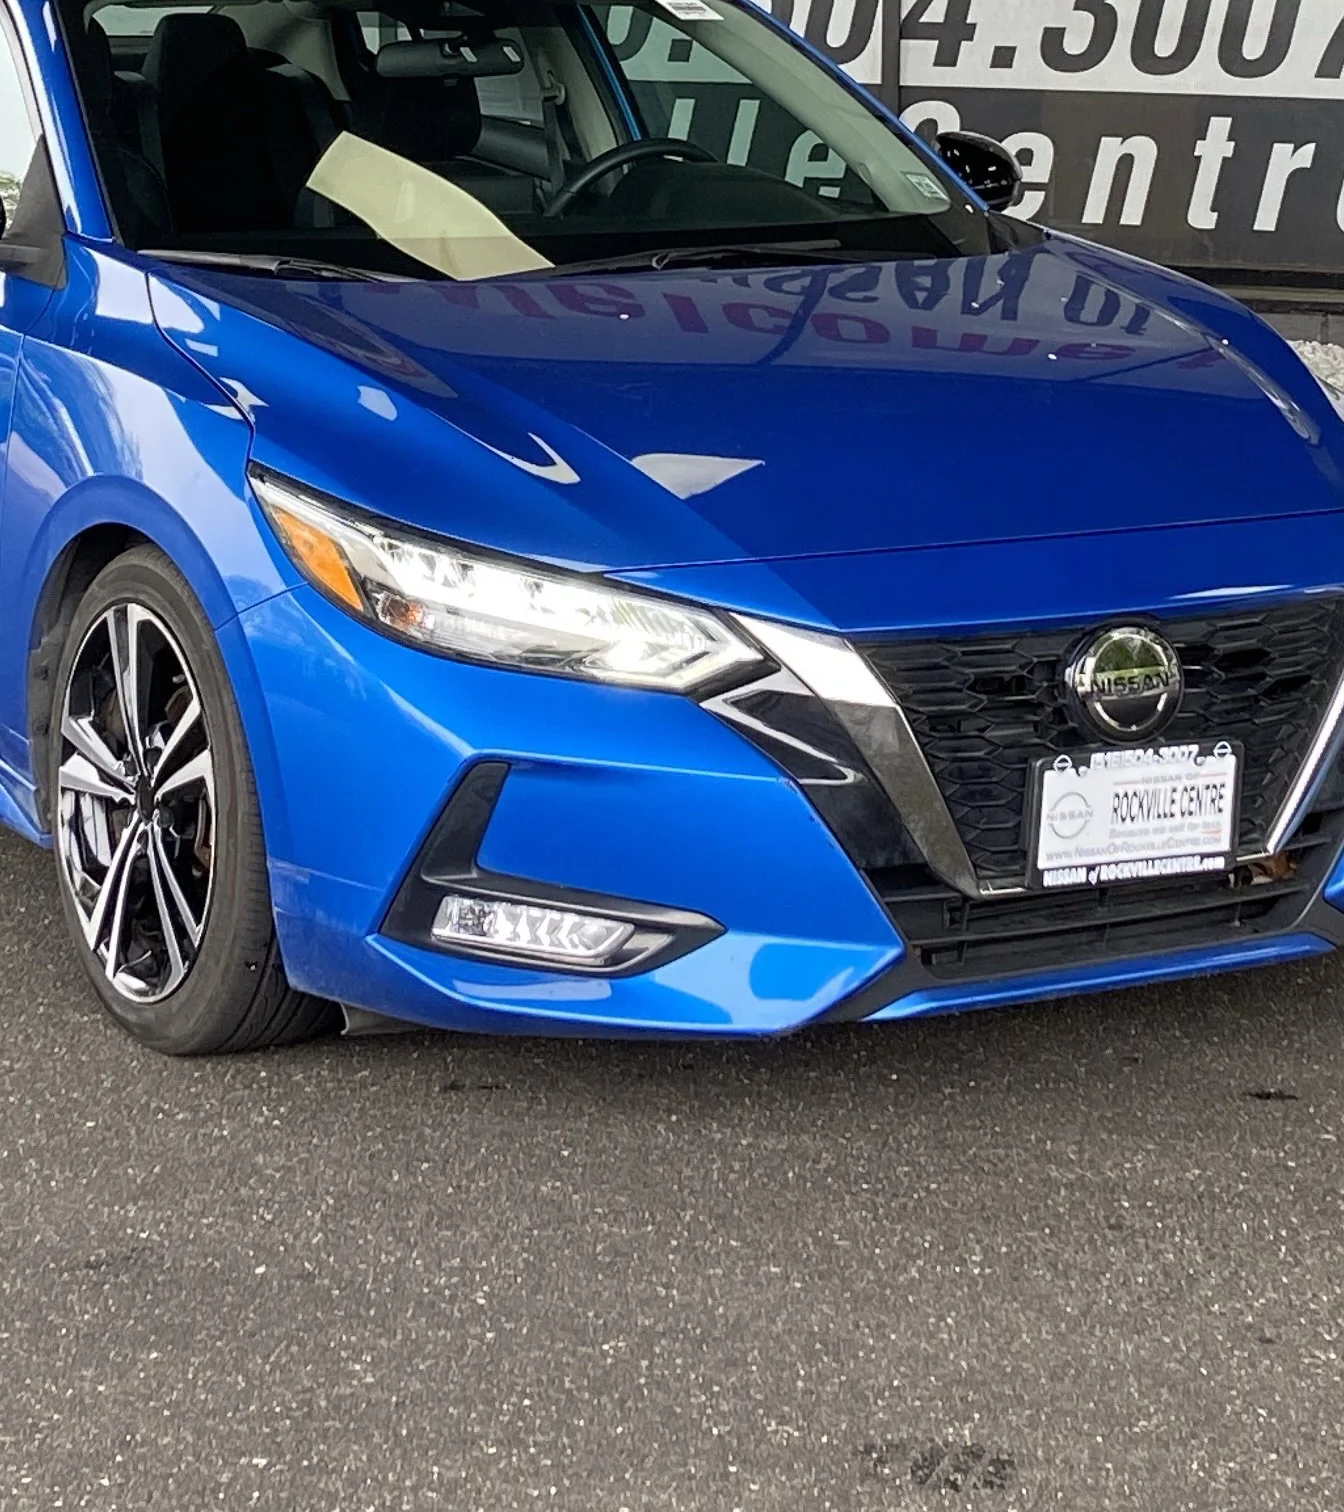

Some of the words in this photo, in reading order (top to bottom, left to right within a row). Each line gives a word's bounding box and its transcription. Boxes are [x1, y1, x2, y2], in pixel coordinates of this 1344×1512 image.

[1090, 671, 1170, 697] NISSAN
[1112, 787, 1177, 825] ROCKVILLE
[1180, 782, 1226, 817] CENTRE
[1047, 809, 1093, 822] NISSAN
[1043, 866, 1087, 887] NISSAN
